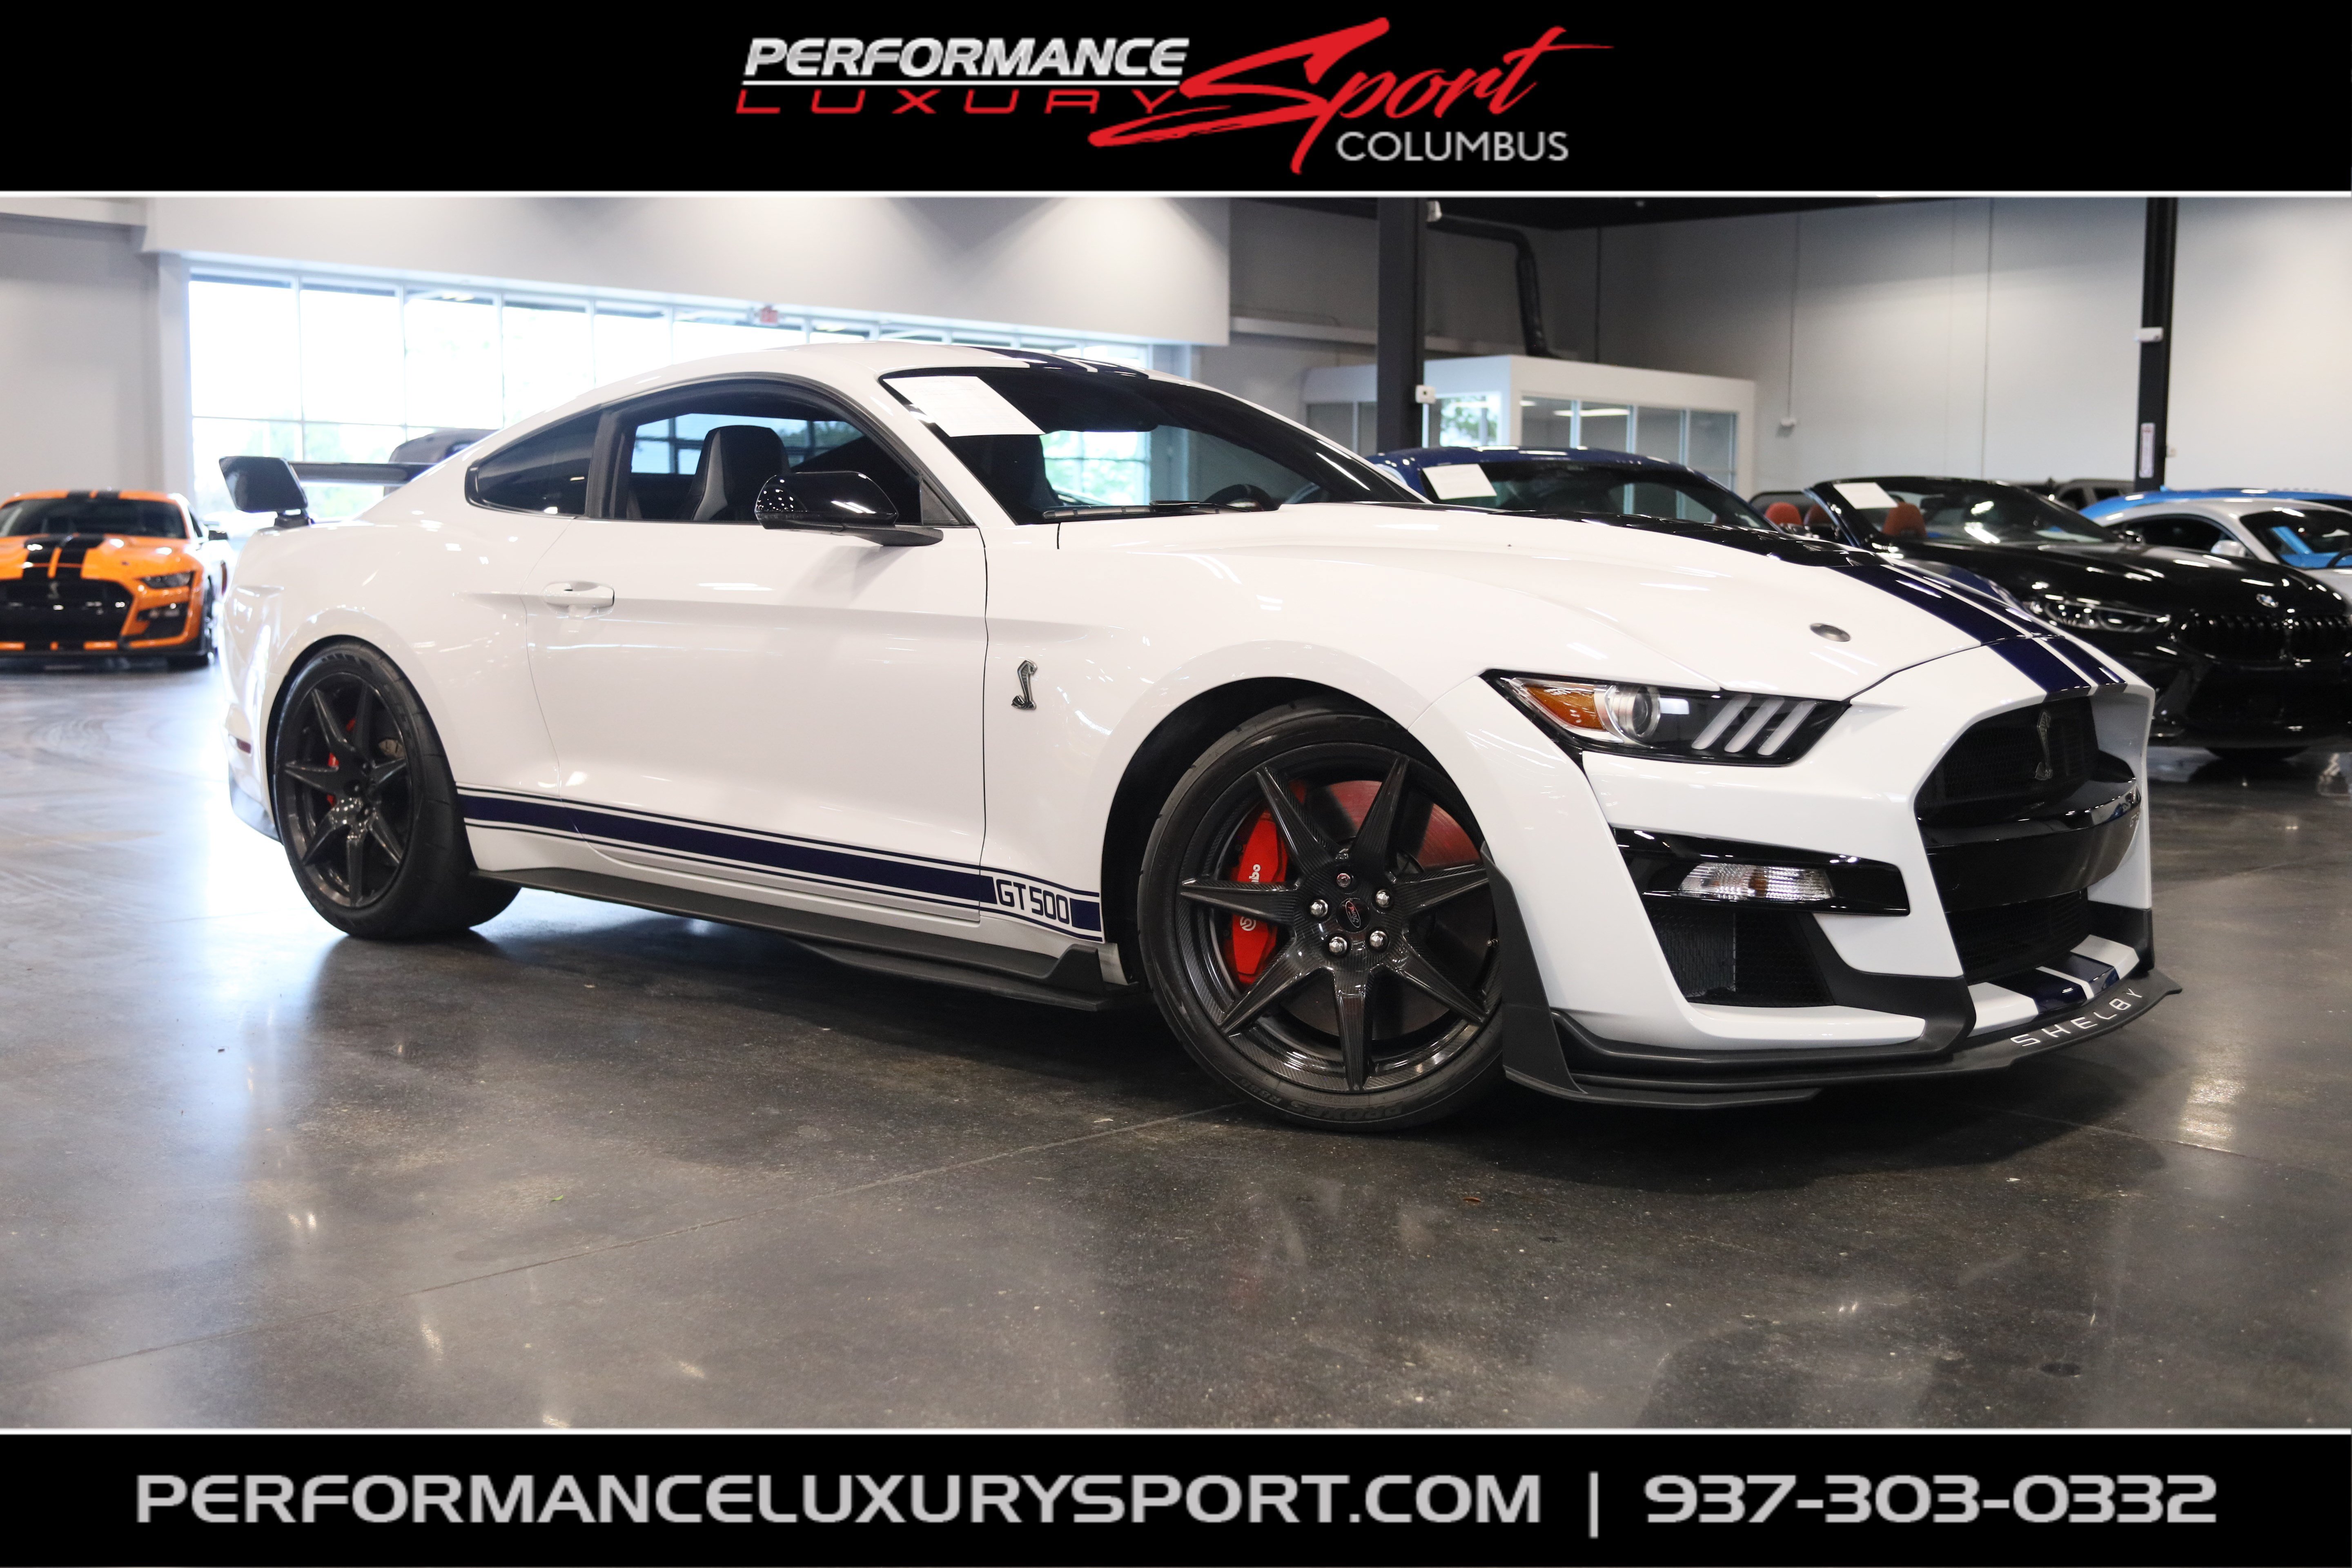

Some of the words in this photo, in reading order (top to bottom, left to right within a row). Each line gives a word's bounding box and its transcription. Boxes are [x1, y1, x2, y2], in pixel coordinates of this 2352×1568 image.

[1348, 906, 1360, 923] Ford
[2010, 988, 2143, 1047] SHELBY
[1287, 1100, 1403, 1120] PROXES
